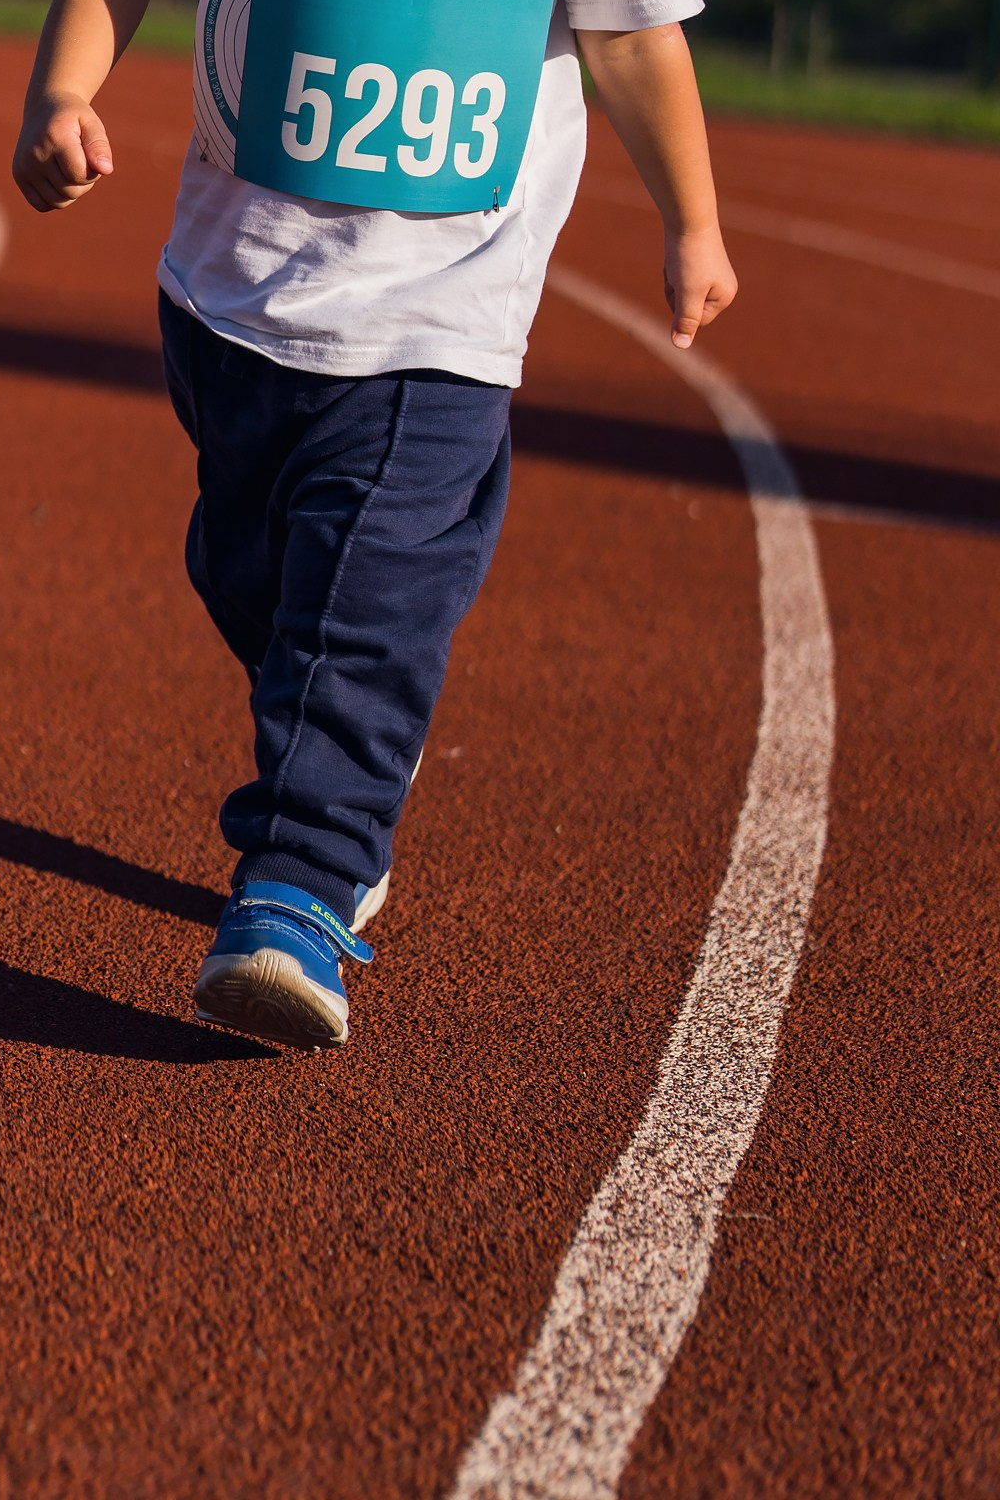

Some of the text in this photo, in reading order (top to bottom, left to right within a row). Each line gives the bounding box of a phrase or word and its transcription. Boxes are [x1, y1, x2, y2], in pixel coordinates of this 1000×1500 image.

[205, 26, 214, 52] забег
[212, 81, 223, 100] 300
[281, 51, 506, 178] 5293
